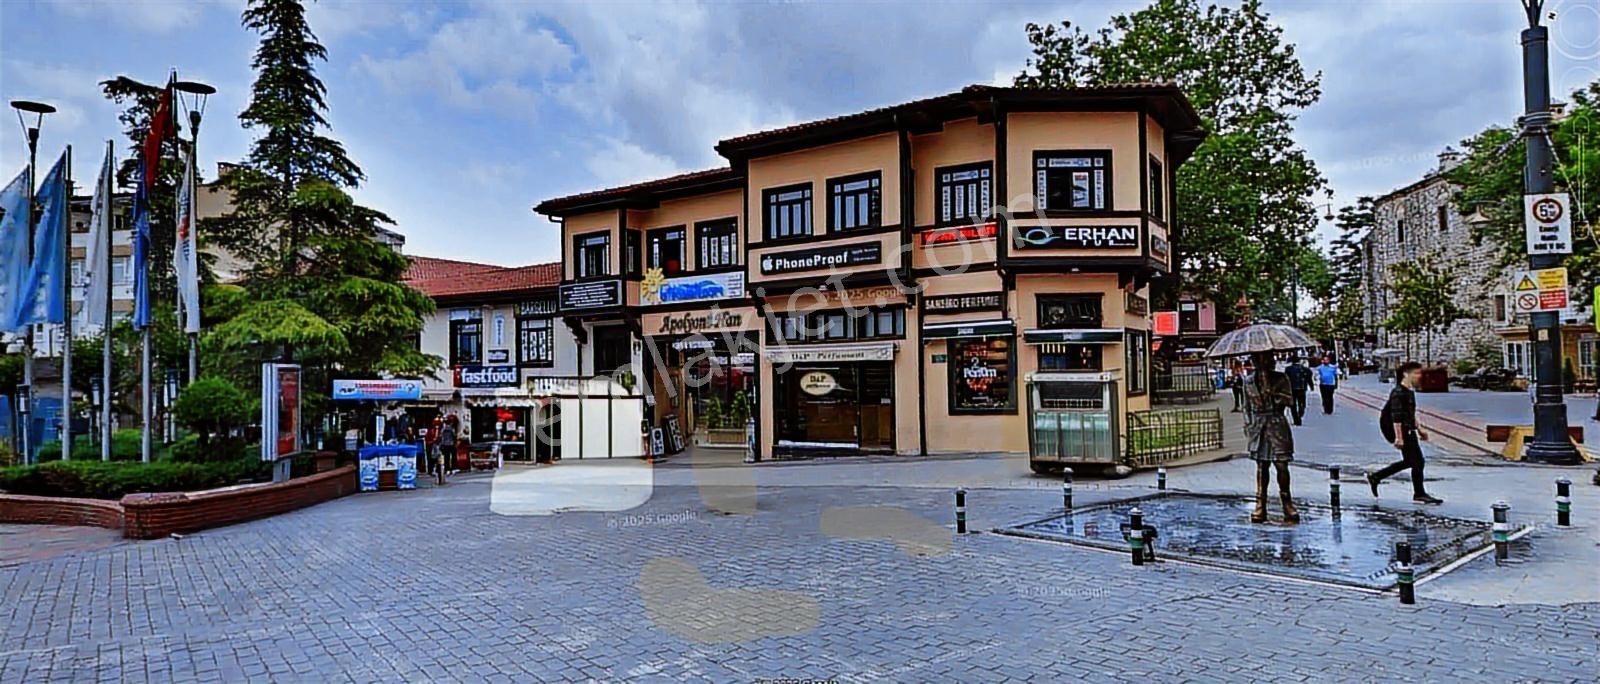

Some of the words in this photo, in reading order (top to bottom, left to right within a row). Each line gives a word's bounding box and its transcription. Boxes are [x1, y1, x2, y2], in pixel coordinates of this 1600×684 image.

[1064, 228, 1135, 240] ERHAN
[775, 251, 848, 271] PhoneProof
[461, 367, 518, 384] fastfood
